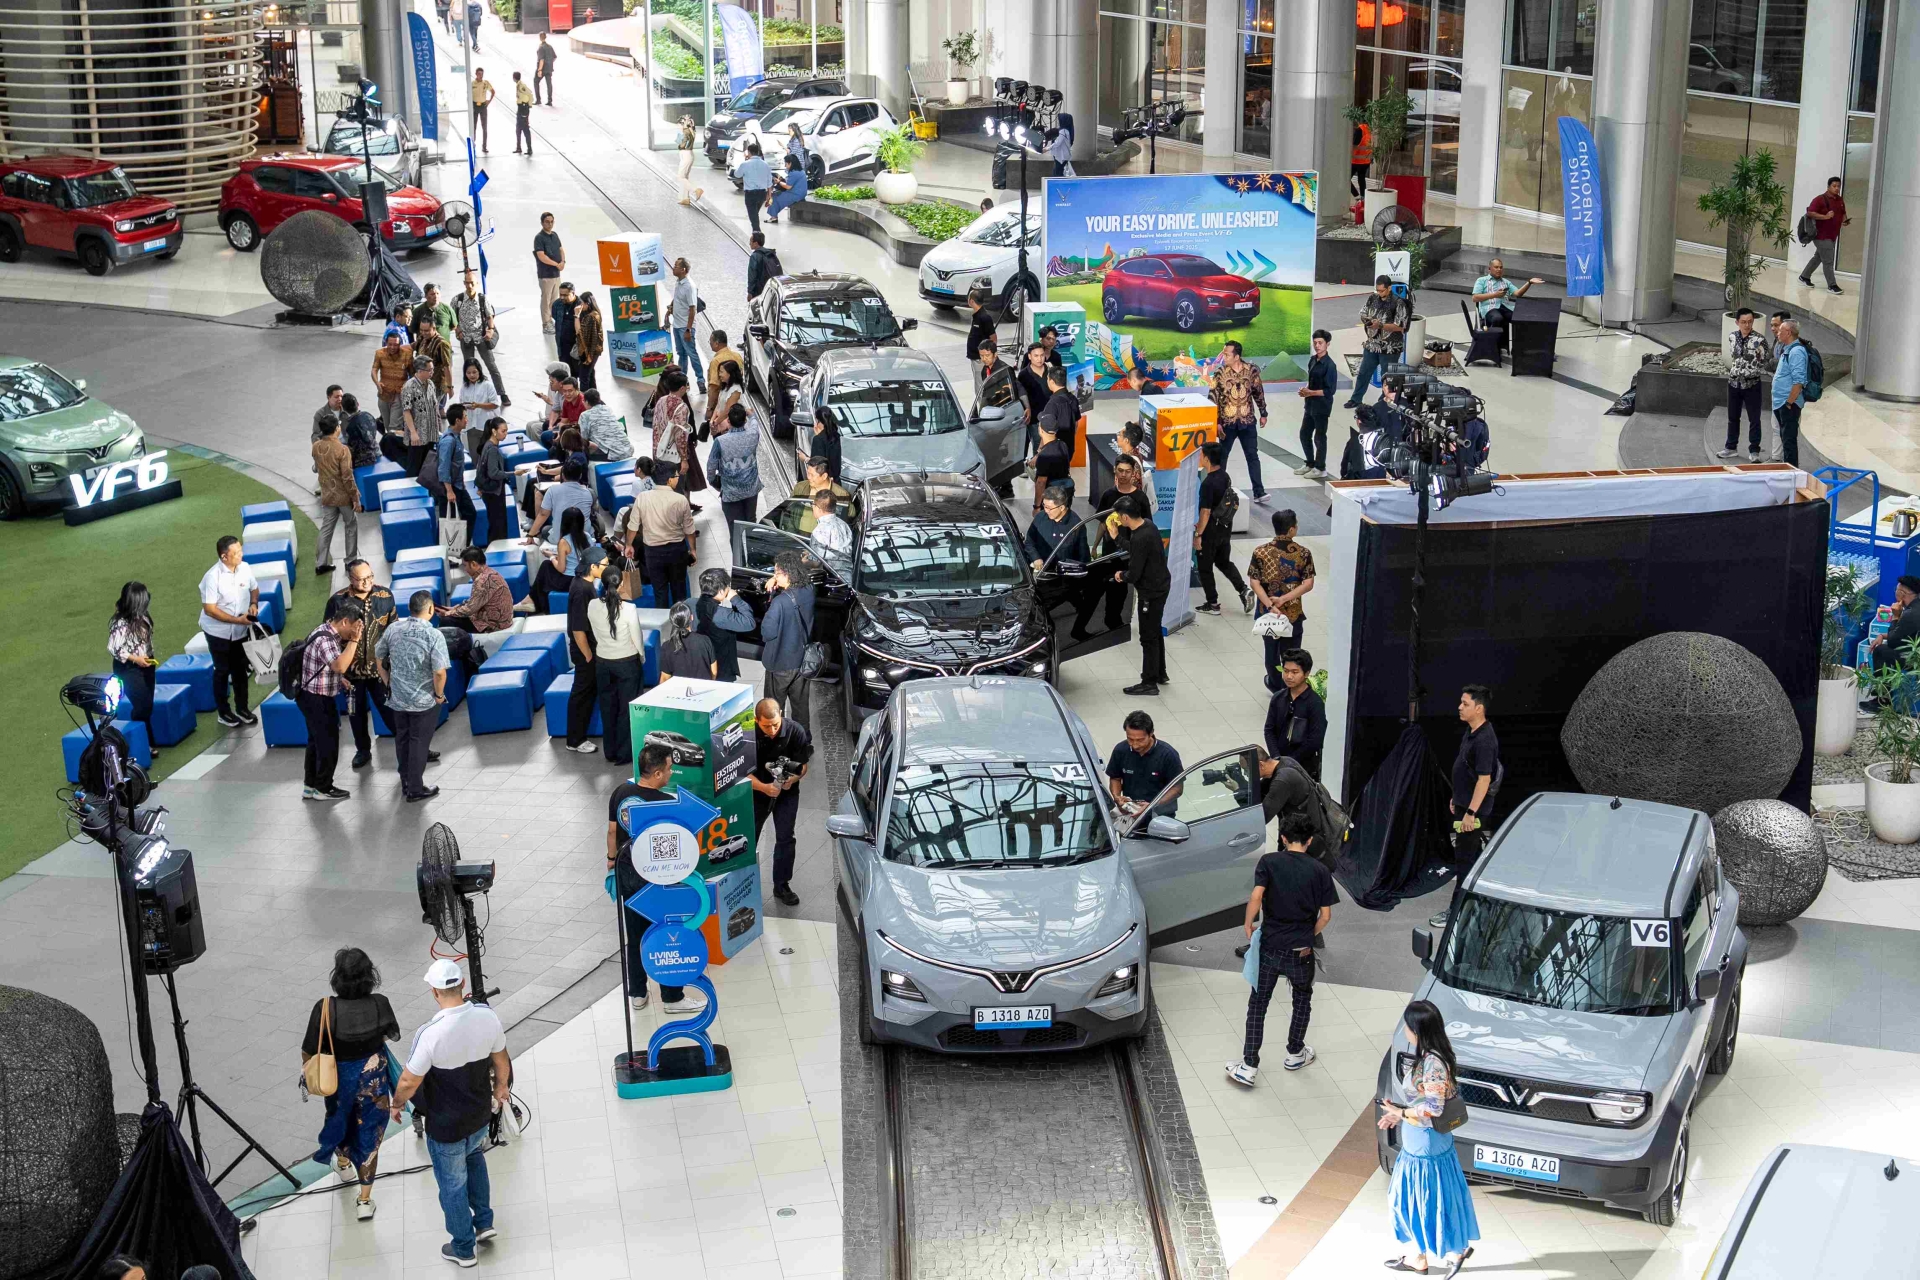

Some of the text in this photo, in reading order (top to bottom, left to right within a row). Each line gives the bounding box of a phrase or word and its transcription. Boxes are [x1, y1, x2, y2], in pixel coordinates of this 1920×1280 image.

[415, 41, 426, 87] LIVING
[422, 30, 434, 99] UNBOUND
[1569, 158, 1582, 220] LIVING
[1579, 141, 1593, 236] UNBOUND
[1085, 210, 1279, 233] YOUR EASY DRIVE. UNLEASHED!
[1169, 430, 1207, 452] 170
[69, 450, 168, 508] VF6
[980, 526, 1004, 535] V2
[717, 755, 745, 780] EKSTERIOR
[1052, 765, 1085, 778] V1
[717, 771, 738, 790] ELEGAN
[1632, 923, 1668, 942] V6
[649, 950, 679, 960] LIVING
[655, 956, 700, 966] UNBOUND
[977, 1008, 1049, 1022] B 1318 AZQ
[1476, 1148, 1556, 1173] B 1306 AZQ
